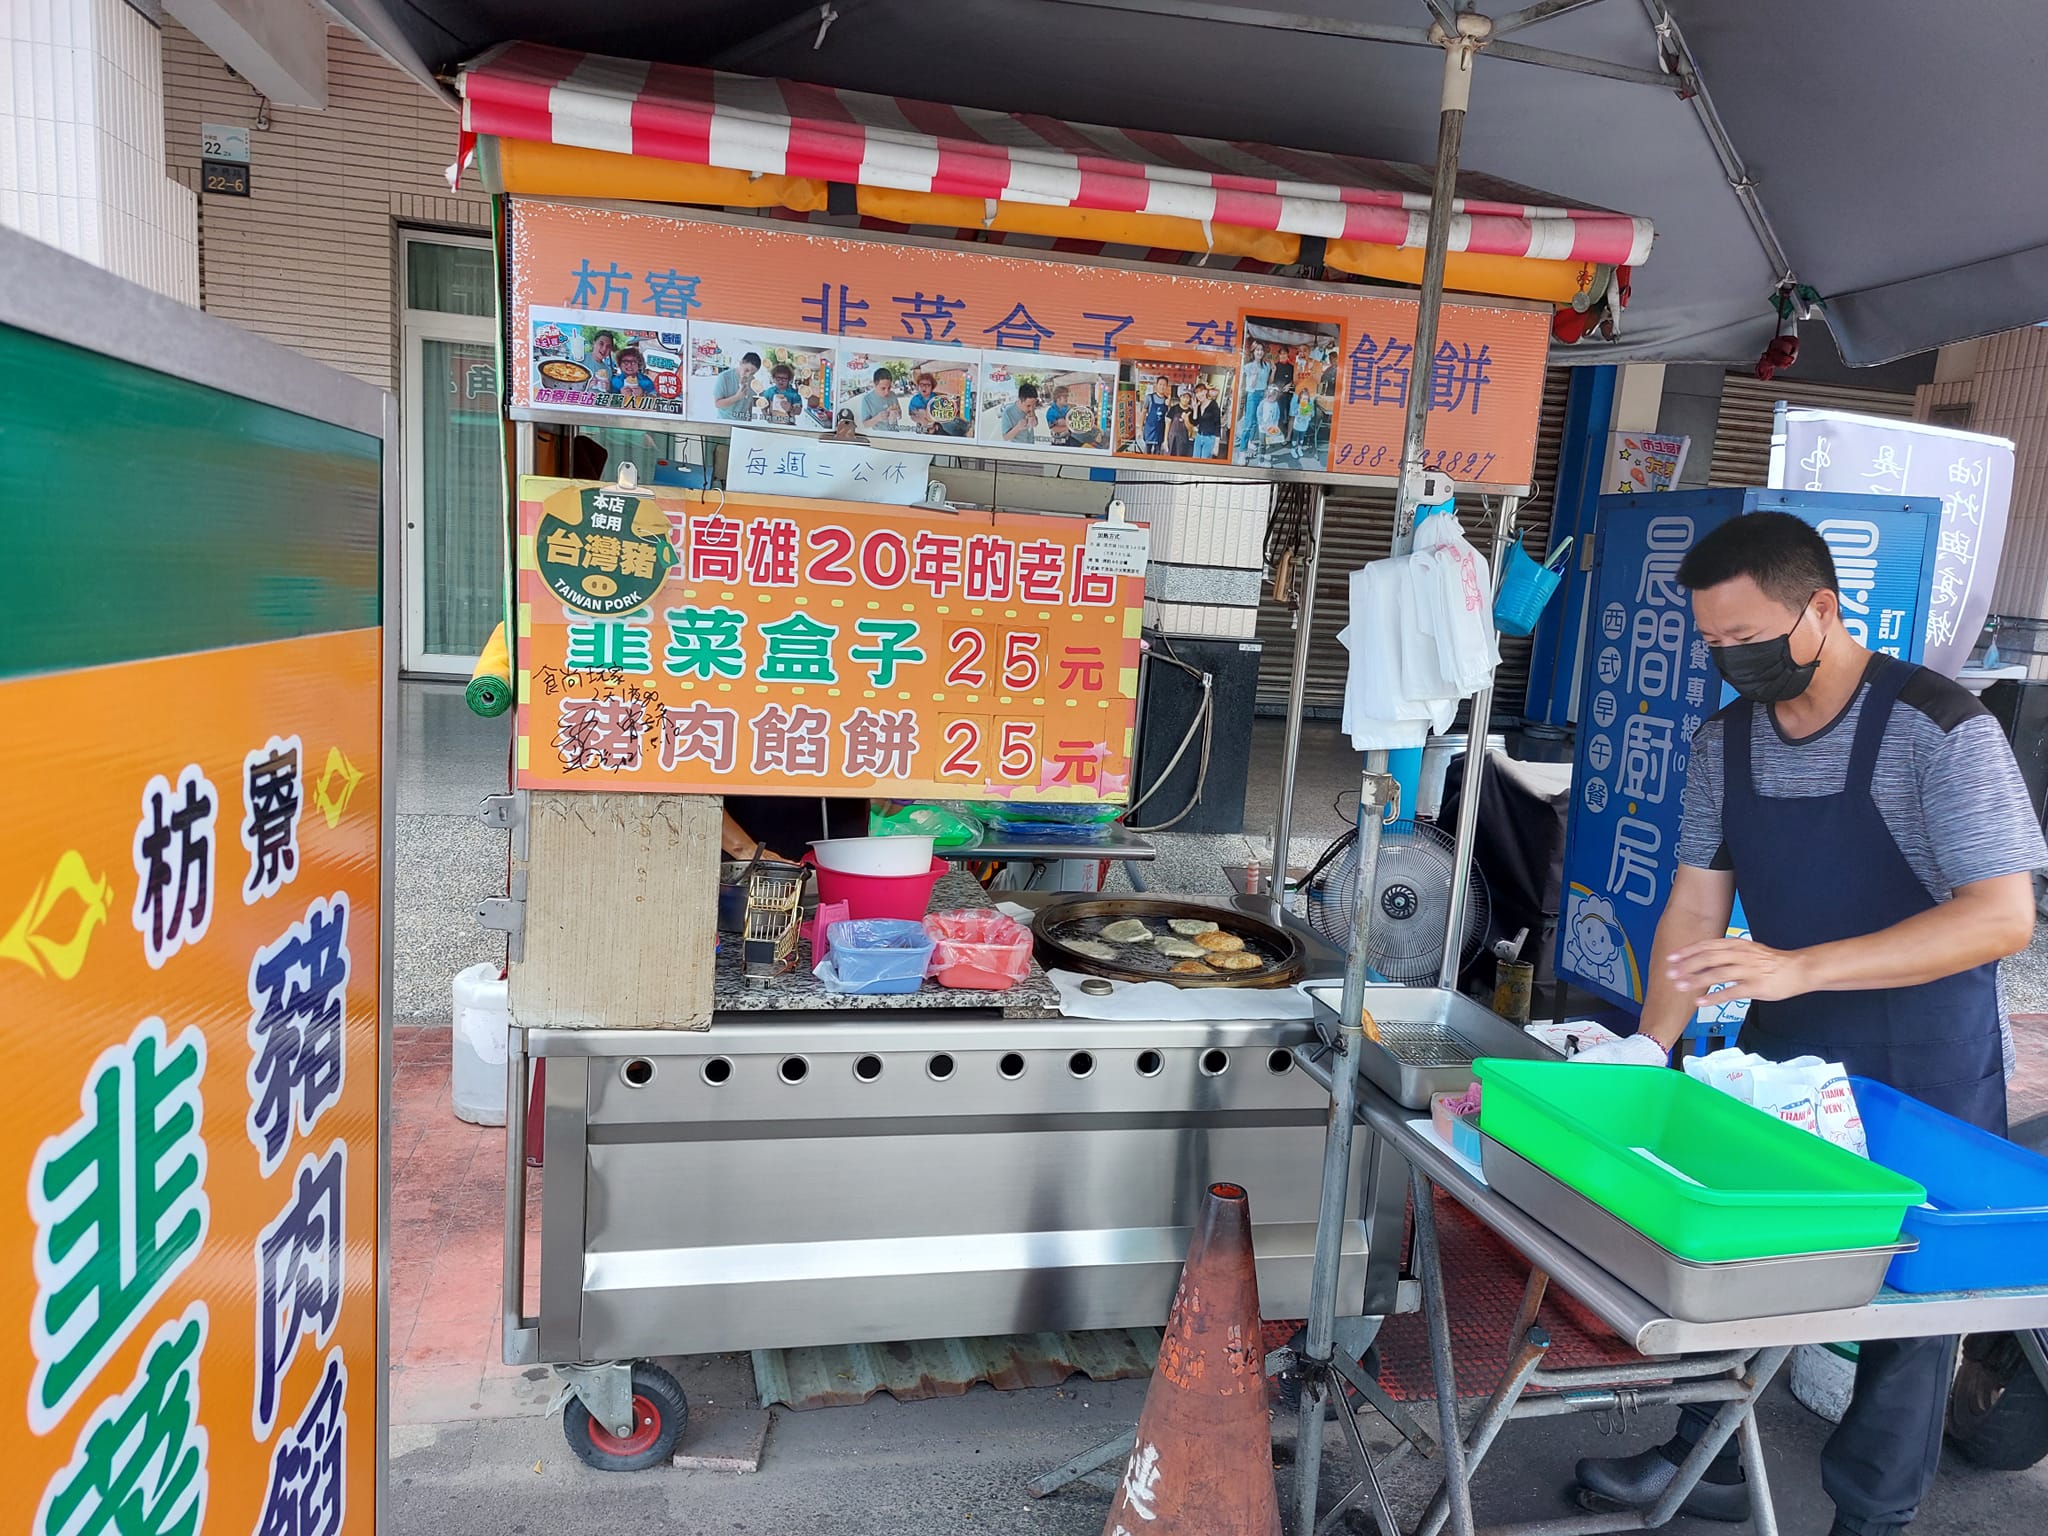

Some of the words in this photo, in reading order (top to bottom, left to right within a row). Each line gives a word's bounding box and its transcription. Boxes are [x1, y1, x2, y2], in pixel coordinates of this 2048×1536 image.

[204, 141, 222, 156] 22
[208, 175, 244, 192] 22-6
[745, 447, 906, 482] 每週二公休
[592, 494, 626, 513] 本店
[590, 512, 622, 532] 使用
[546, 527, 657, 580] 台灣豬
[554, 578, 602, 611] TAIWAN
[605, 591, 642, 611] PORK
[566, 603, 928, 686] 韭菜盒子
[532, 662, 626, 696] 食尚玩家
[1584, 601, 1628, 814] 西式早午餐
[559, 700, 918, 779] 豬肉餡餅
[138, 745, 302, 955] 枋寮
